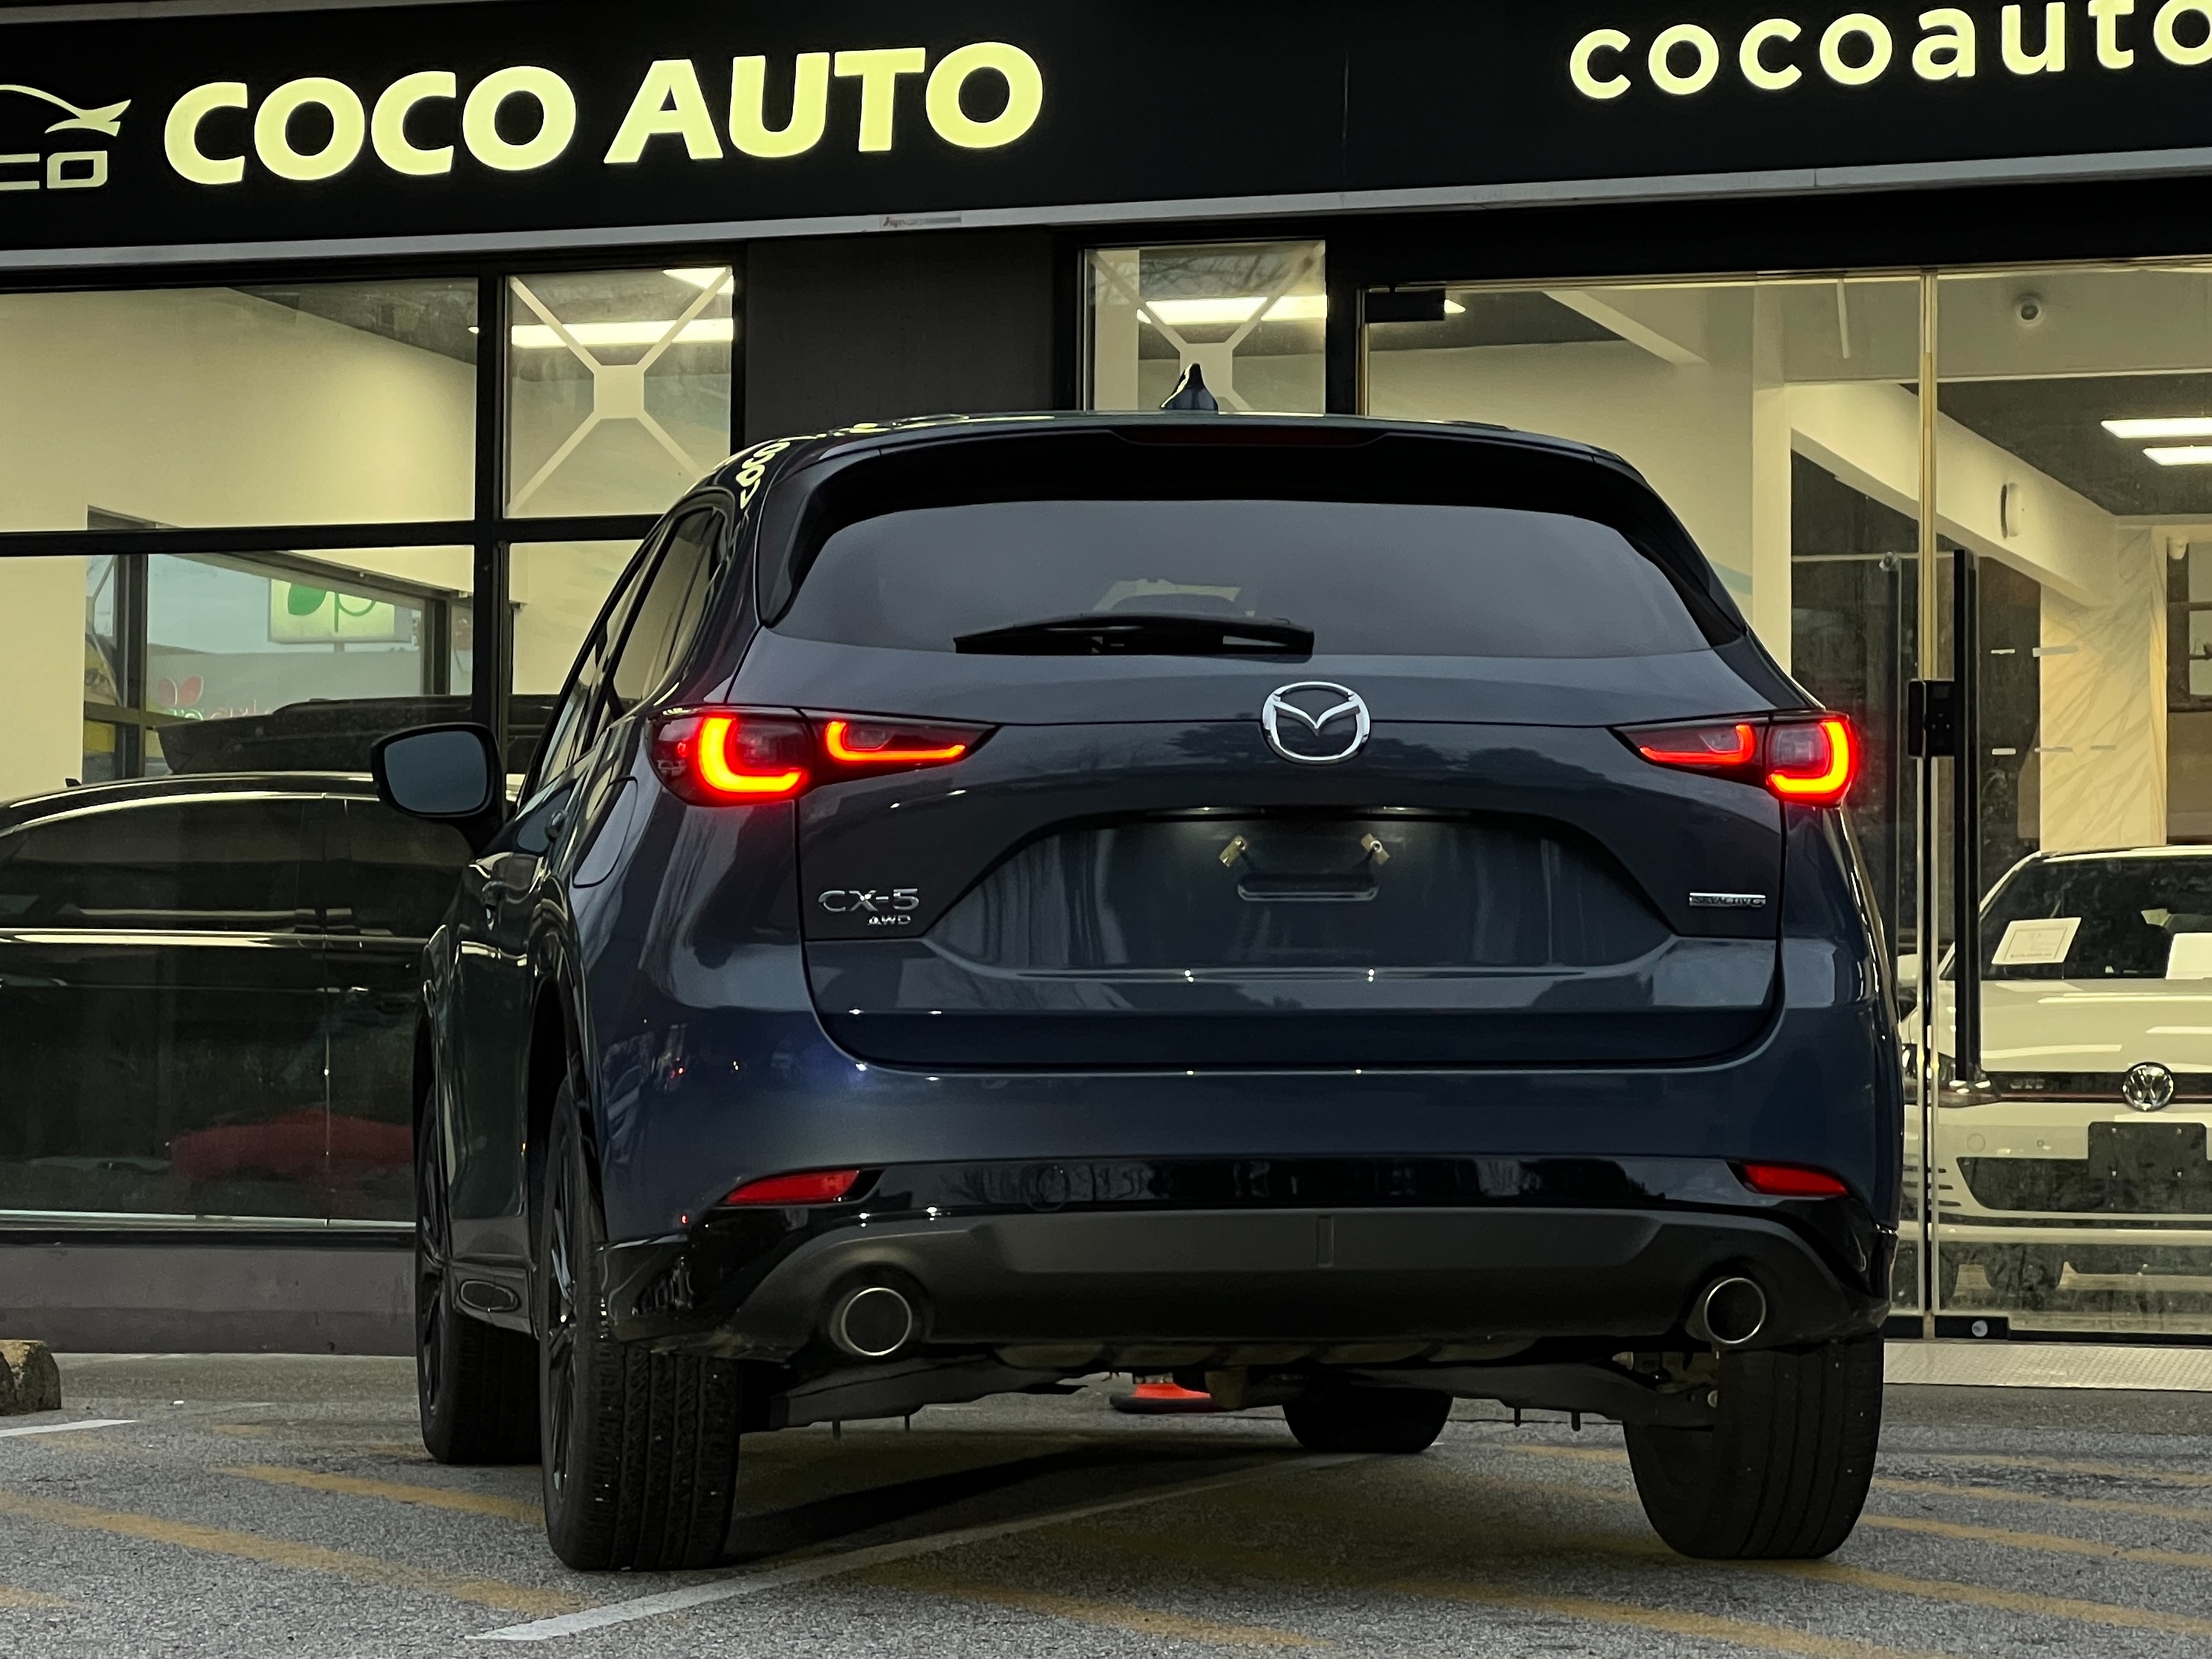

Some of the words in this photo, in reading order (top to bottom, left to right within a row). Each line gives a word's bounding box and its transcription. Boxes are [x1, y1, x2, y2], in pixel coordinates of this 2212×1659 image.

[164, 65, 577, 185] COCO
[603, 41, 1044, 164] AUTO
[818, 888, 919, 912] CX-5
[867, 915, 911, 926] AWD
